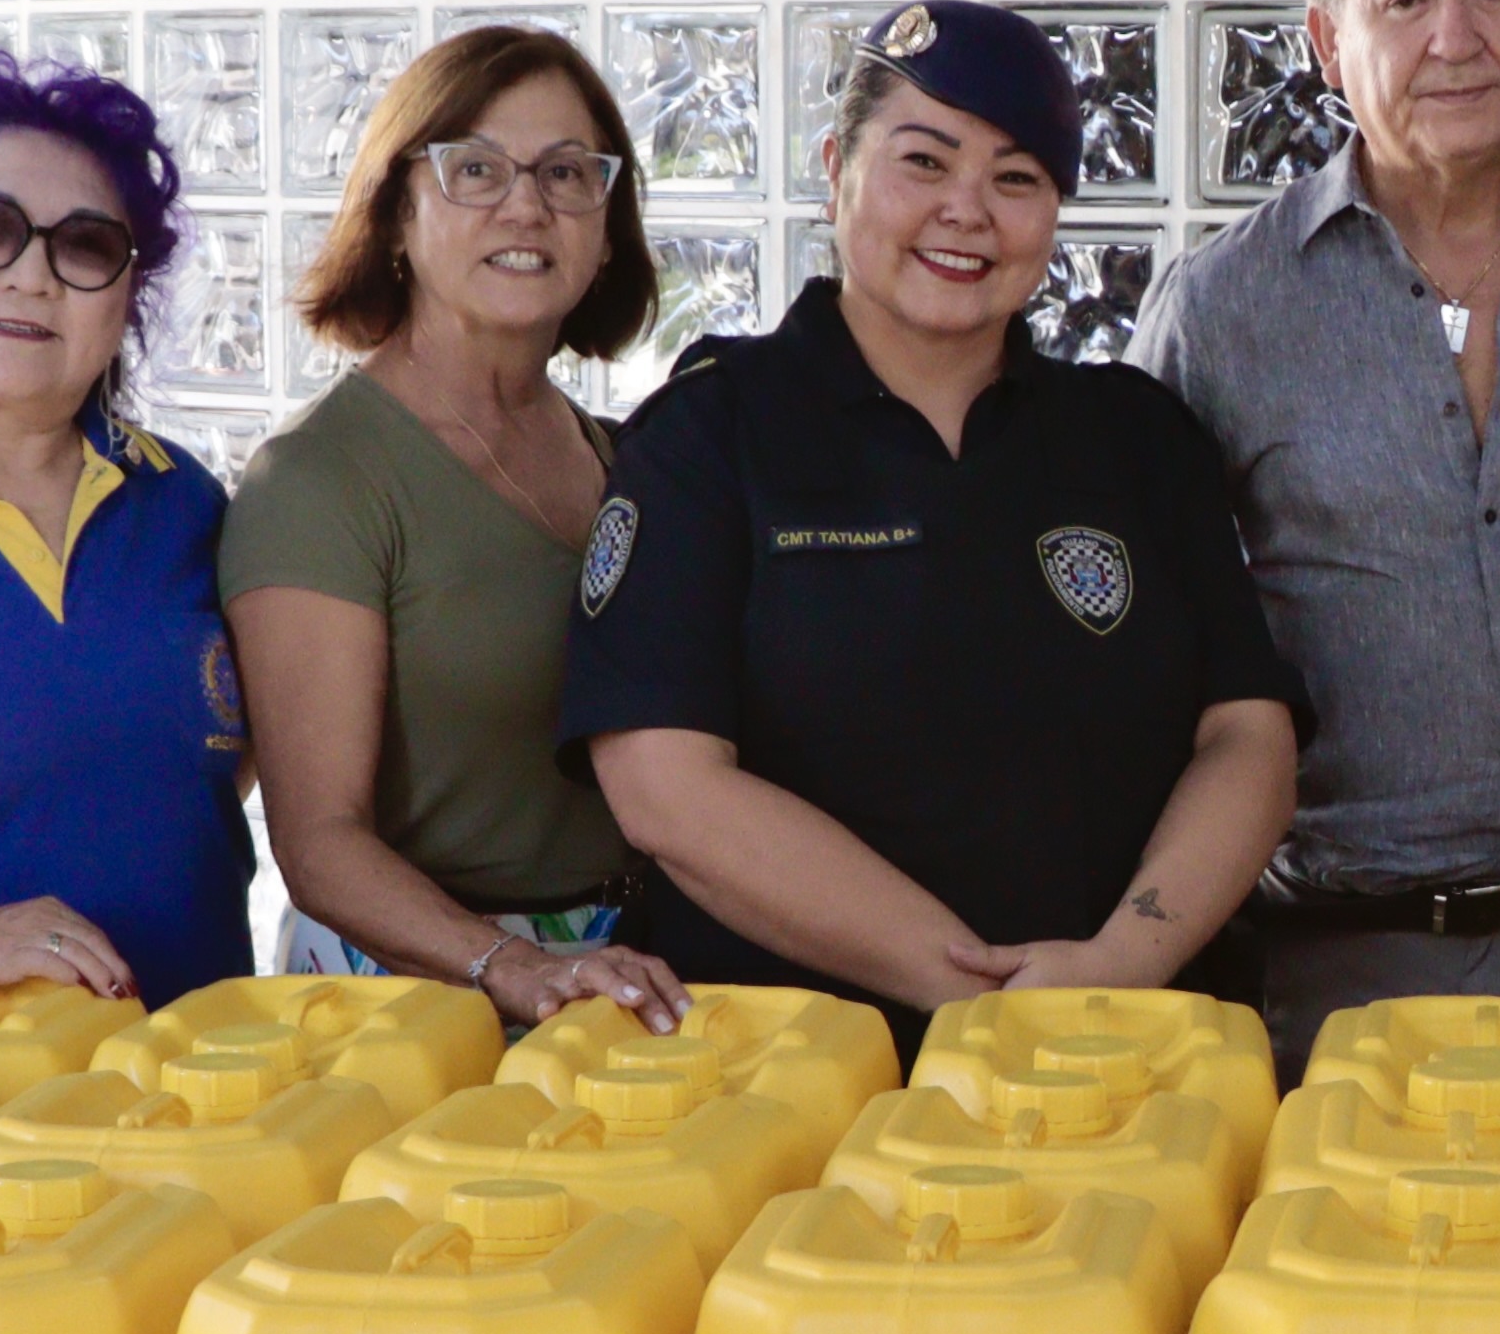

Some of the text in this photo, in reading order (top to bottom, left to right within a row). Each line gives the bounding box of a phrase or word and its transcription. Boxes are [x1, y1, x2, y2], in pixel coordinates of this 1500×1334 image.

[777, 527, 916, 546] CMT TATIANA B+
